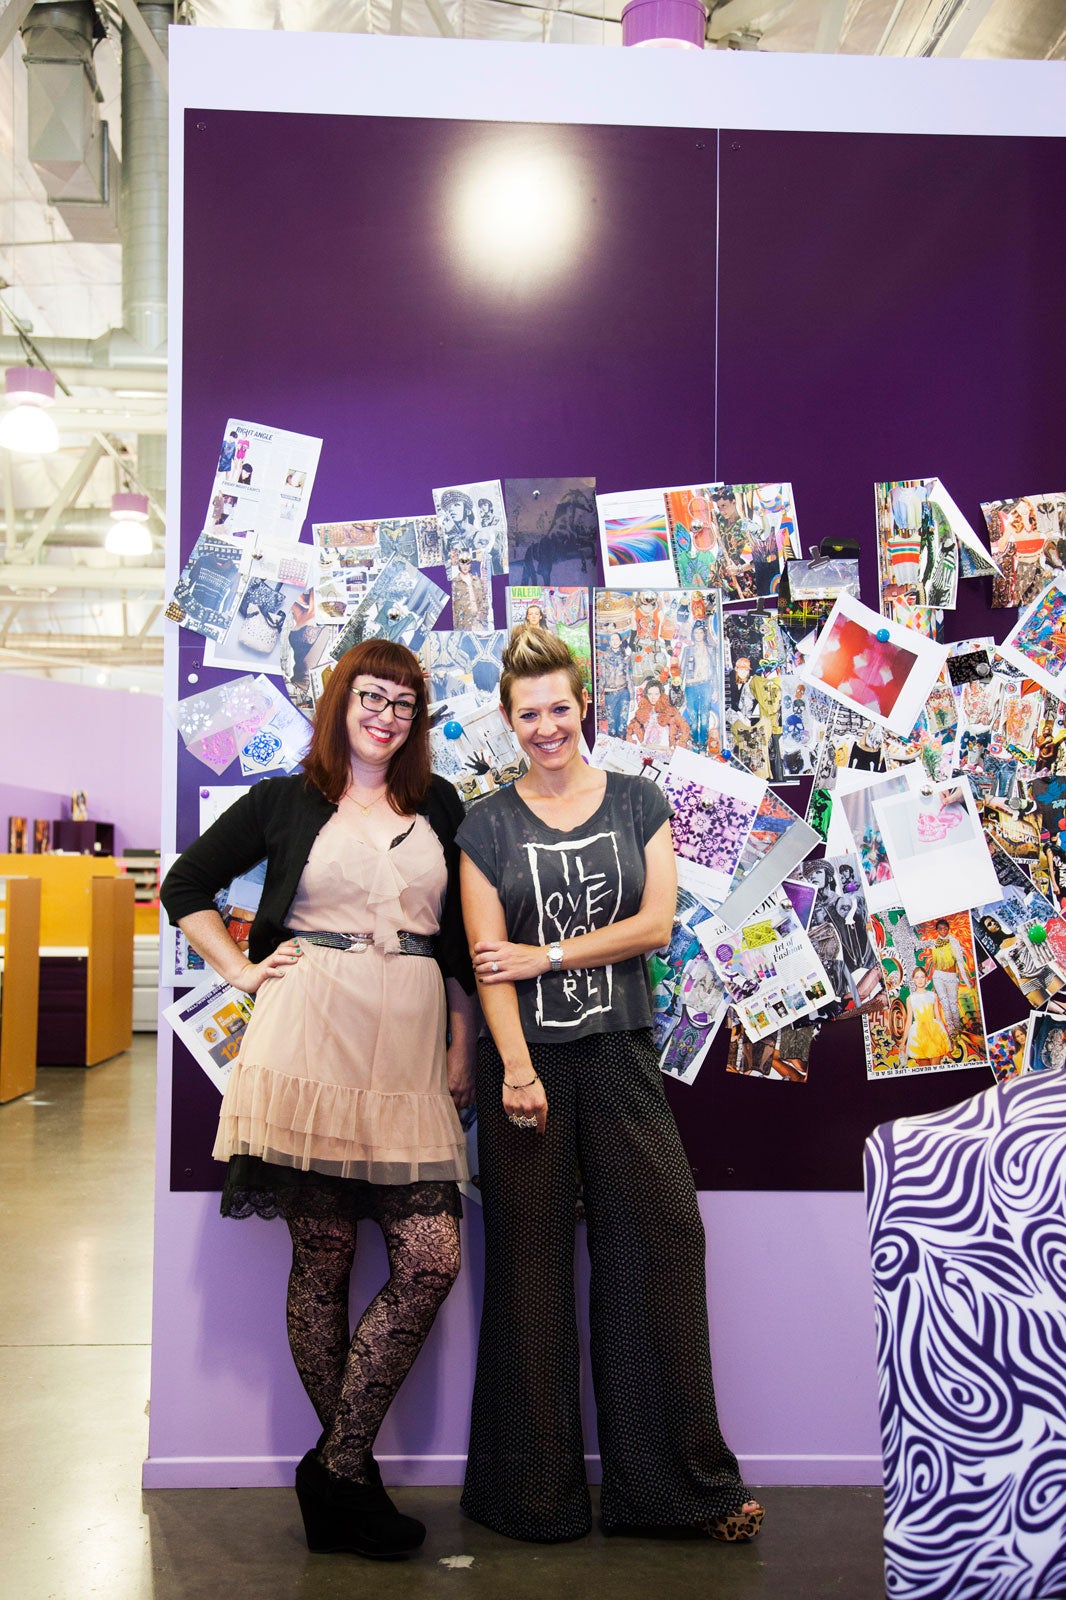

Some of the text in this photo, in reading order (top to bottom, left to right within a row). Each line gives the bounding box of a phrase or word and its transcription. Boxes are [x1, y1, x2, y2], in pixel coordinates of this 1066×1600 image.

[236, 426, 273, 440] RIGHT ANGLE
[773, 944, 803, 962] Fashion
